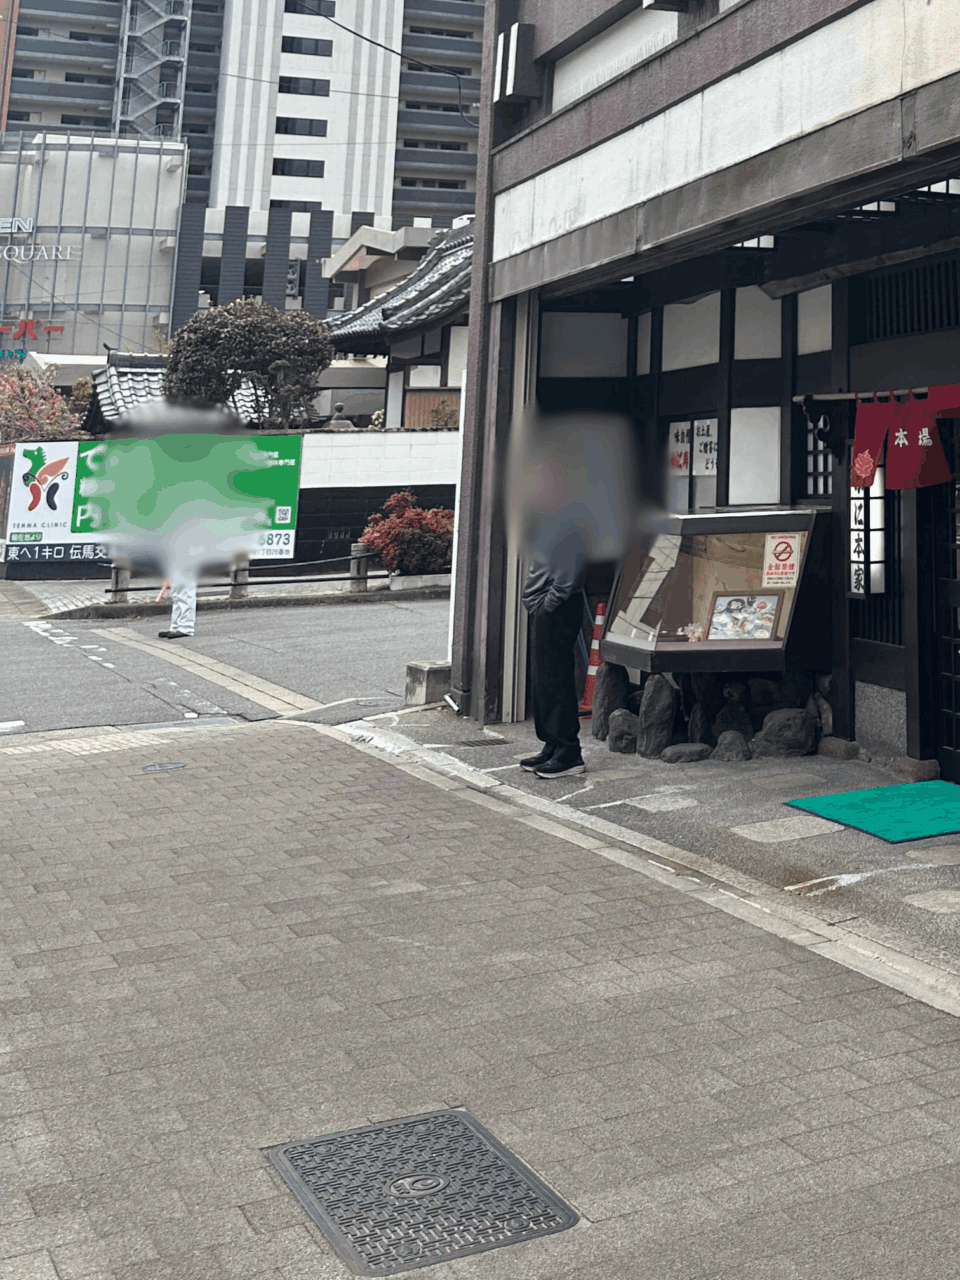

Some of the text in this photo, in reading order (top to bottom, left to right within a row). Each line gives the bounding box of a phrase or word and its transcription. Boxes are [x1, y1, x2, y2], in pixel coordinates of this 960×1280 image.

[0, 245, 76, 263] QUARE
[894, 427, 933, 448] 本場
[852, 487, 866, 592] に本家
